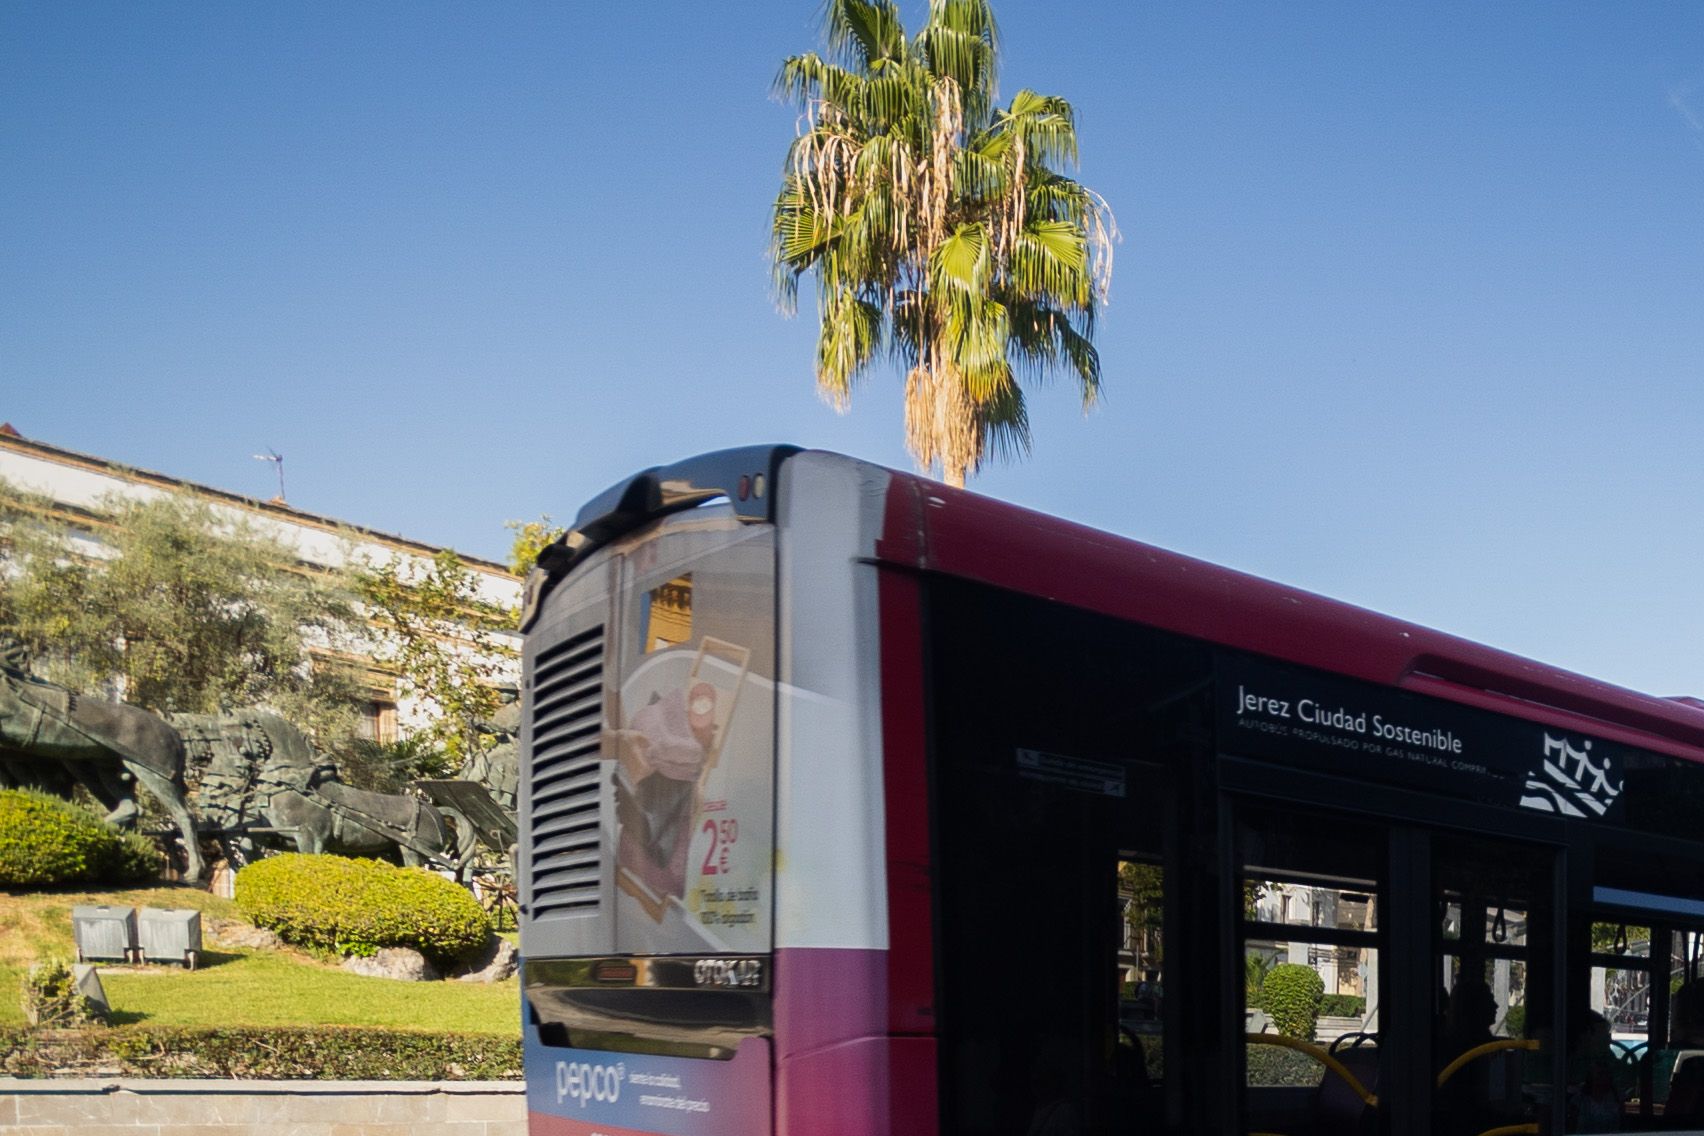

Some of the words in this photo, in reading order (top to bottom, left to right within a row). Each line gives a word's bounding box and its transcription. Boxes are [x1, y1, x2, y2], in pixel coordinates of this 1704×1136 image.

[1236, 685, 1291, 718] Jerez
[1297, 699, 1367, 733] Ciudad
[1372, 714, 1463, 754] Sostenible
[1362, 742, 1382, 754] POR
[1385, 746, 1404, 759] GAS
[702, 818, 718, 875] 2
